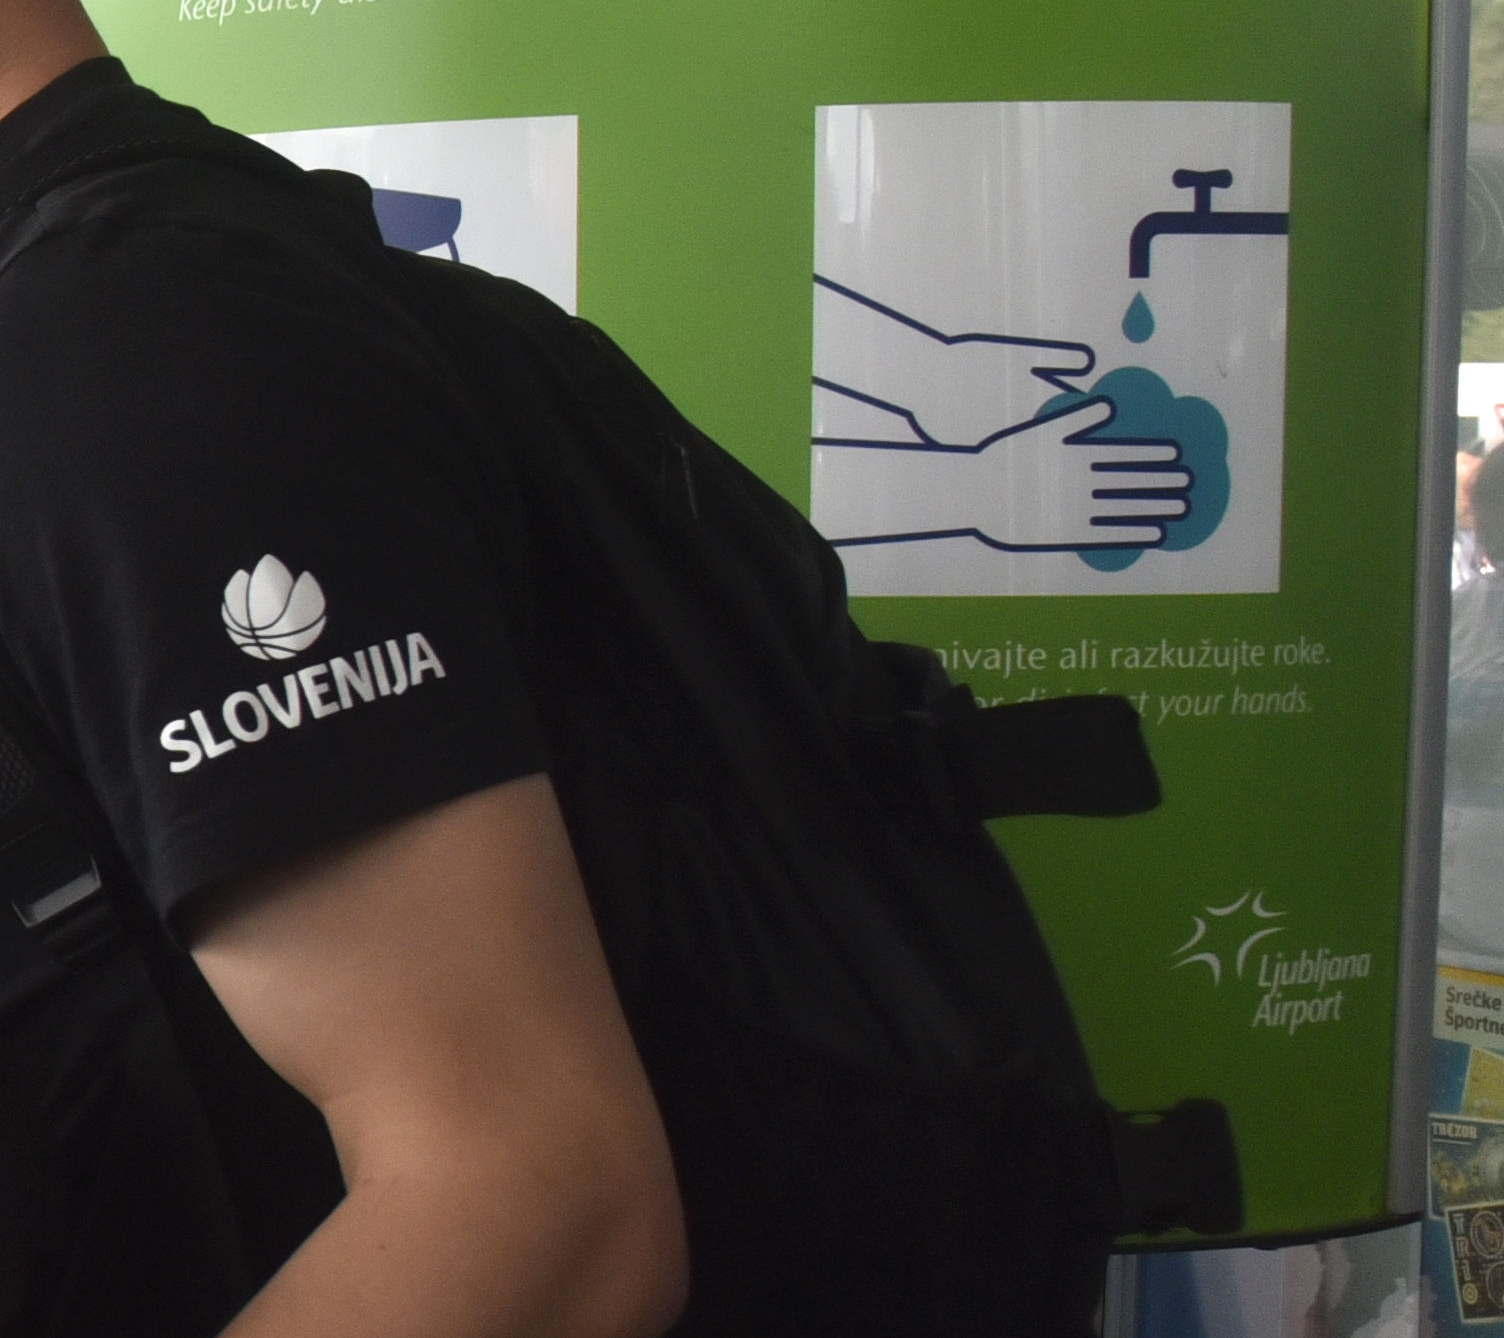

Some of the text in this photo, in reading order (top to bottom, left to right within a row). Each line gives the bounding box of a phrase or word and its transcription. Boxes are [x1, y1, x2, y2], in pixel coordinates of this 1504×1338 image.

[1058, 638, 1098, 670] ali
[1110, 637, 1266, 676] razkužujte
[1273, 634, 1331, 666] roke.
[159, 632, 446, 774] SLOVENIJA
[1156, 693, 1225, 726] your
[1230, 683, 1312, 715] hands.
[1257, 948, 1372, 995] Ljubljana
[1251, 991, 1344, 1037] Airport
[1445, 985, 1503, 1013] Srečke
